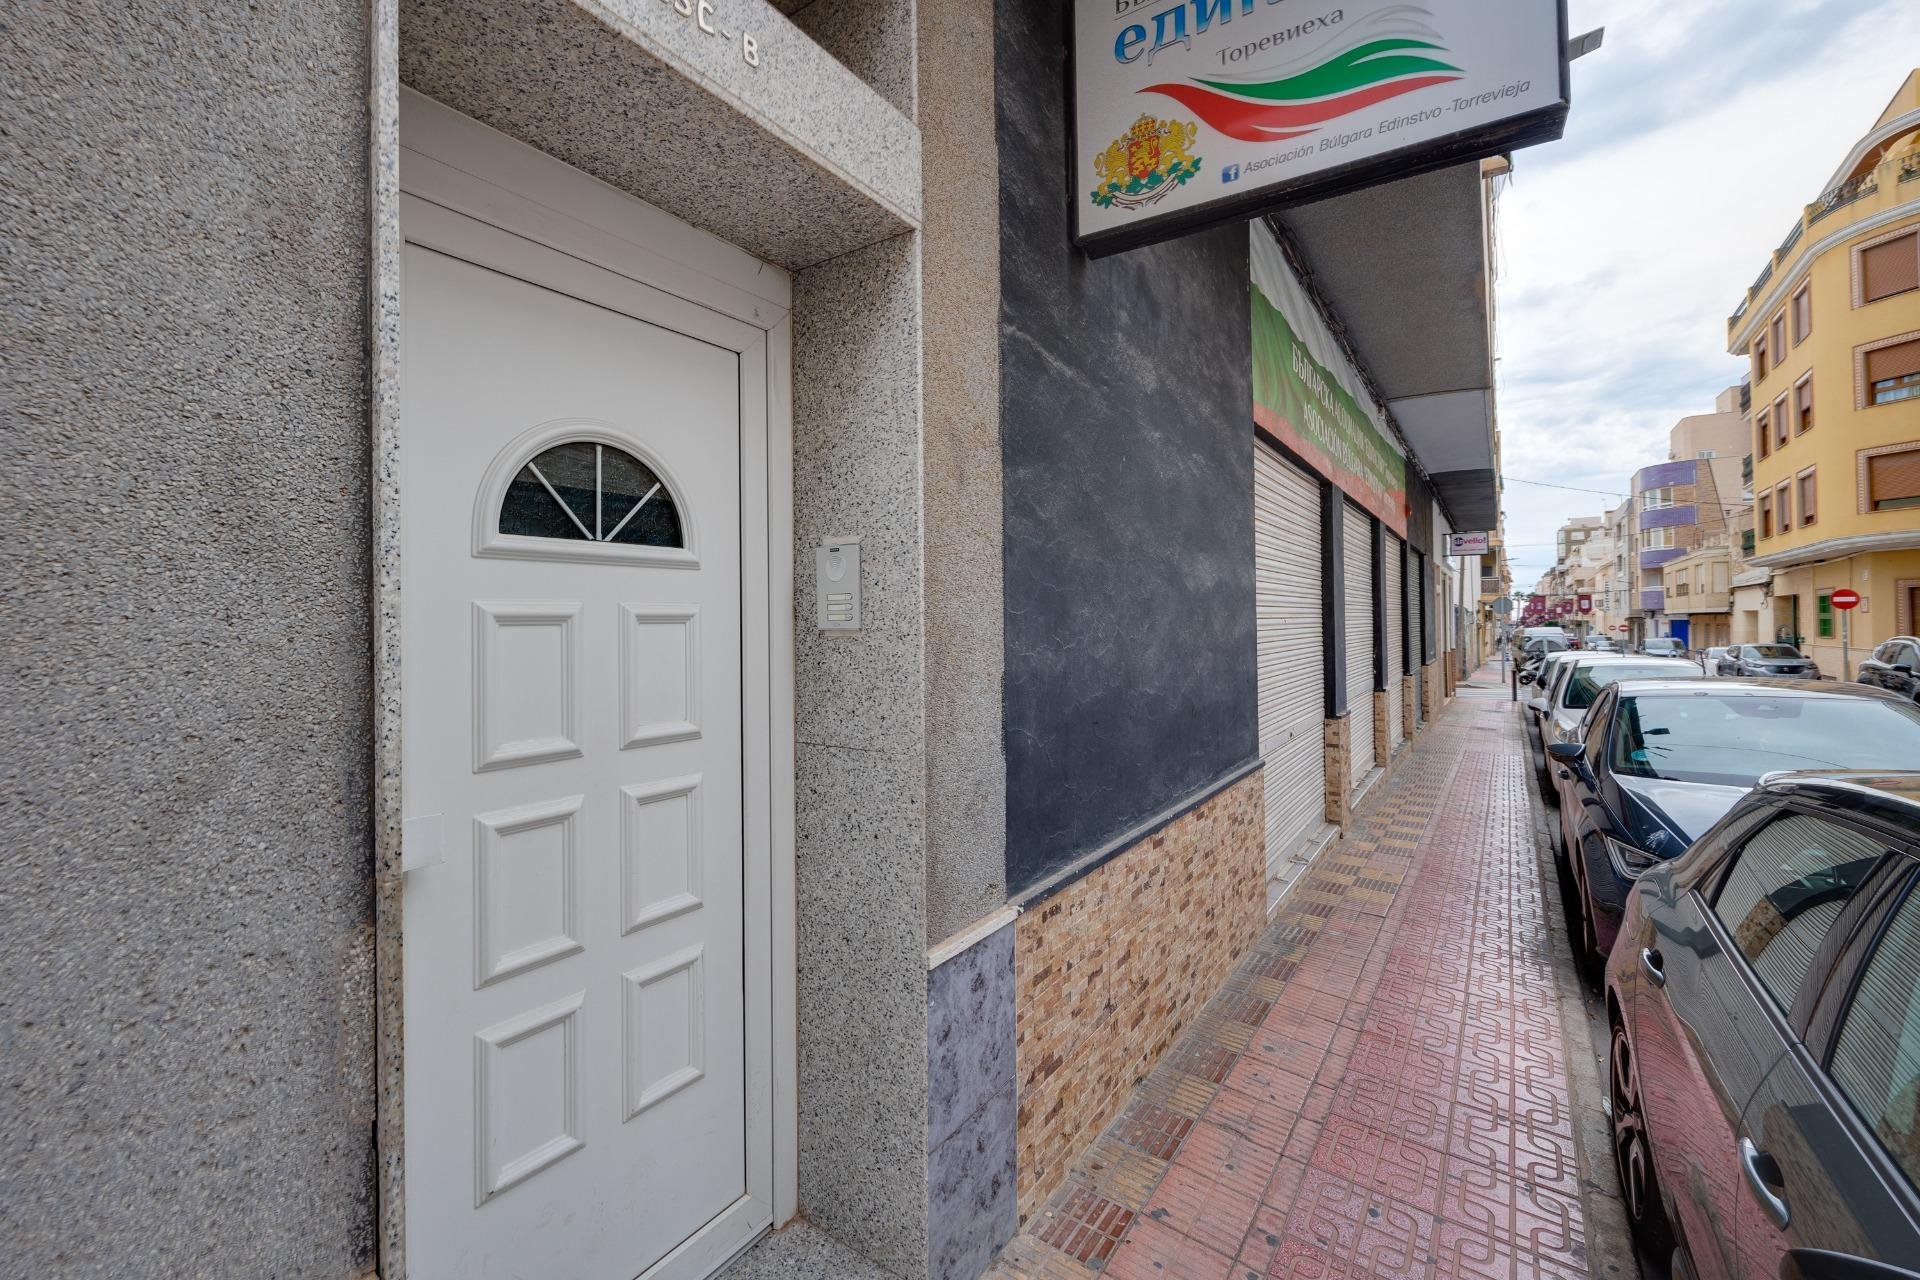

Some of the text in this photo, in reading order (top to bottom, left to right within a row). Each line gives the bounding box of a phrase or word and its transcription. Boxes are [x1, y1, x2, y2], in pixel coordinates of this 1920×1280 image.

[1216, 8, 1345, 66] Торевиеха
[1243, 144, 1314, 174] Asociación
[1319, 127, 1373, 152] Búlgara
[1378, 106, 1442, 134] Edinstvo
[1291, 341, 1336, 417] БЪЛГАРСКА
